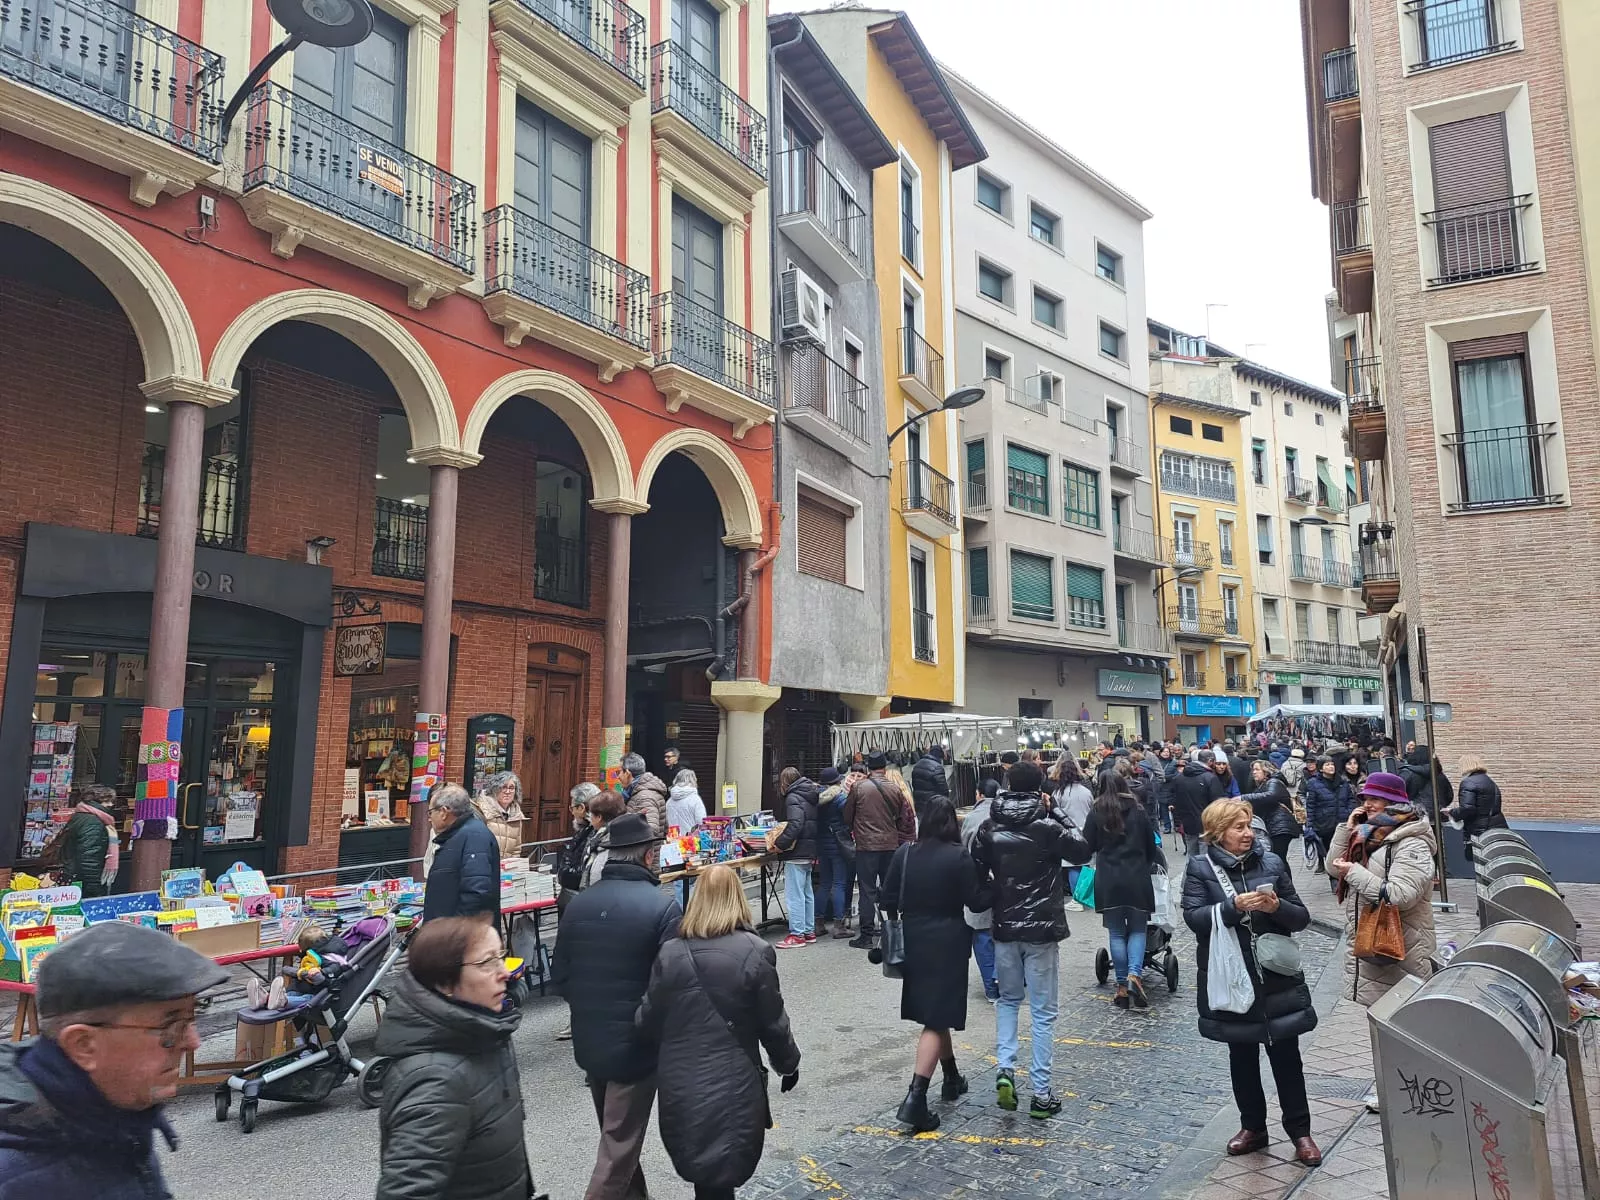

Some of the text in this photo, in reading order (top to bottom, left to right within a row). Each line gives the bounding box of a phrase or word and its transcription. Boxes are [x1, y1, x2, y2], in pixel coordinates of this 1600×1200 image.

[359, 147, 404, 178] SE VENDE
[1217, 869, 1231, 888] LOLA
